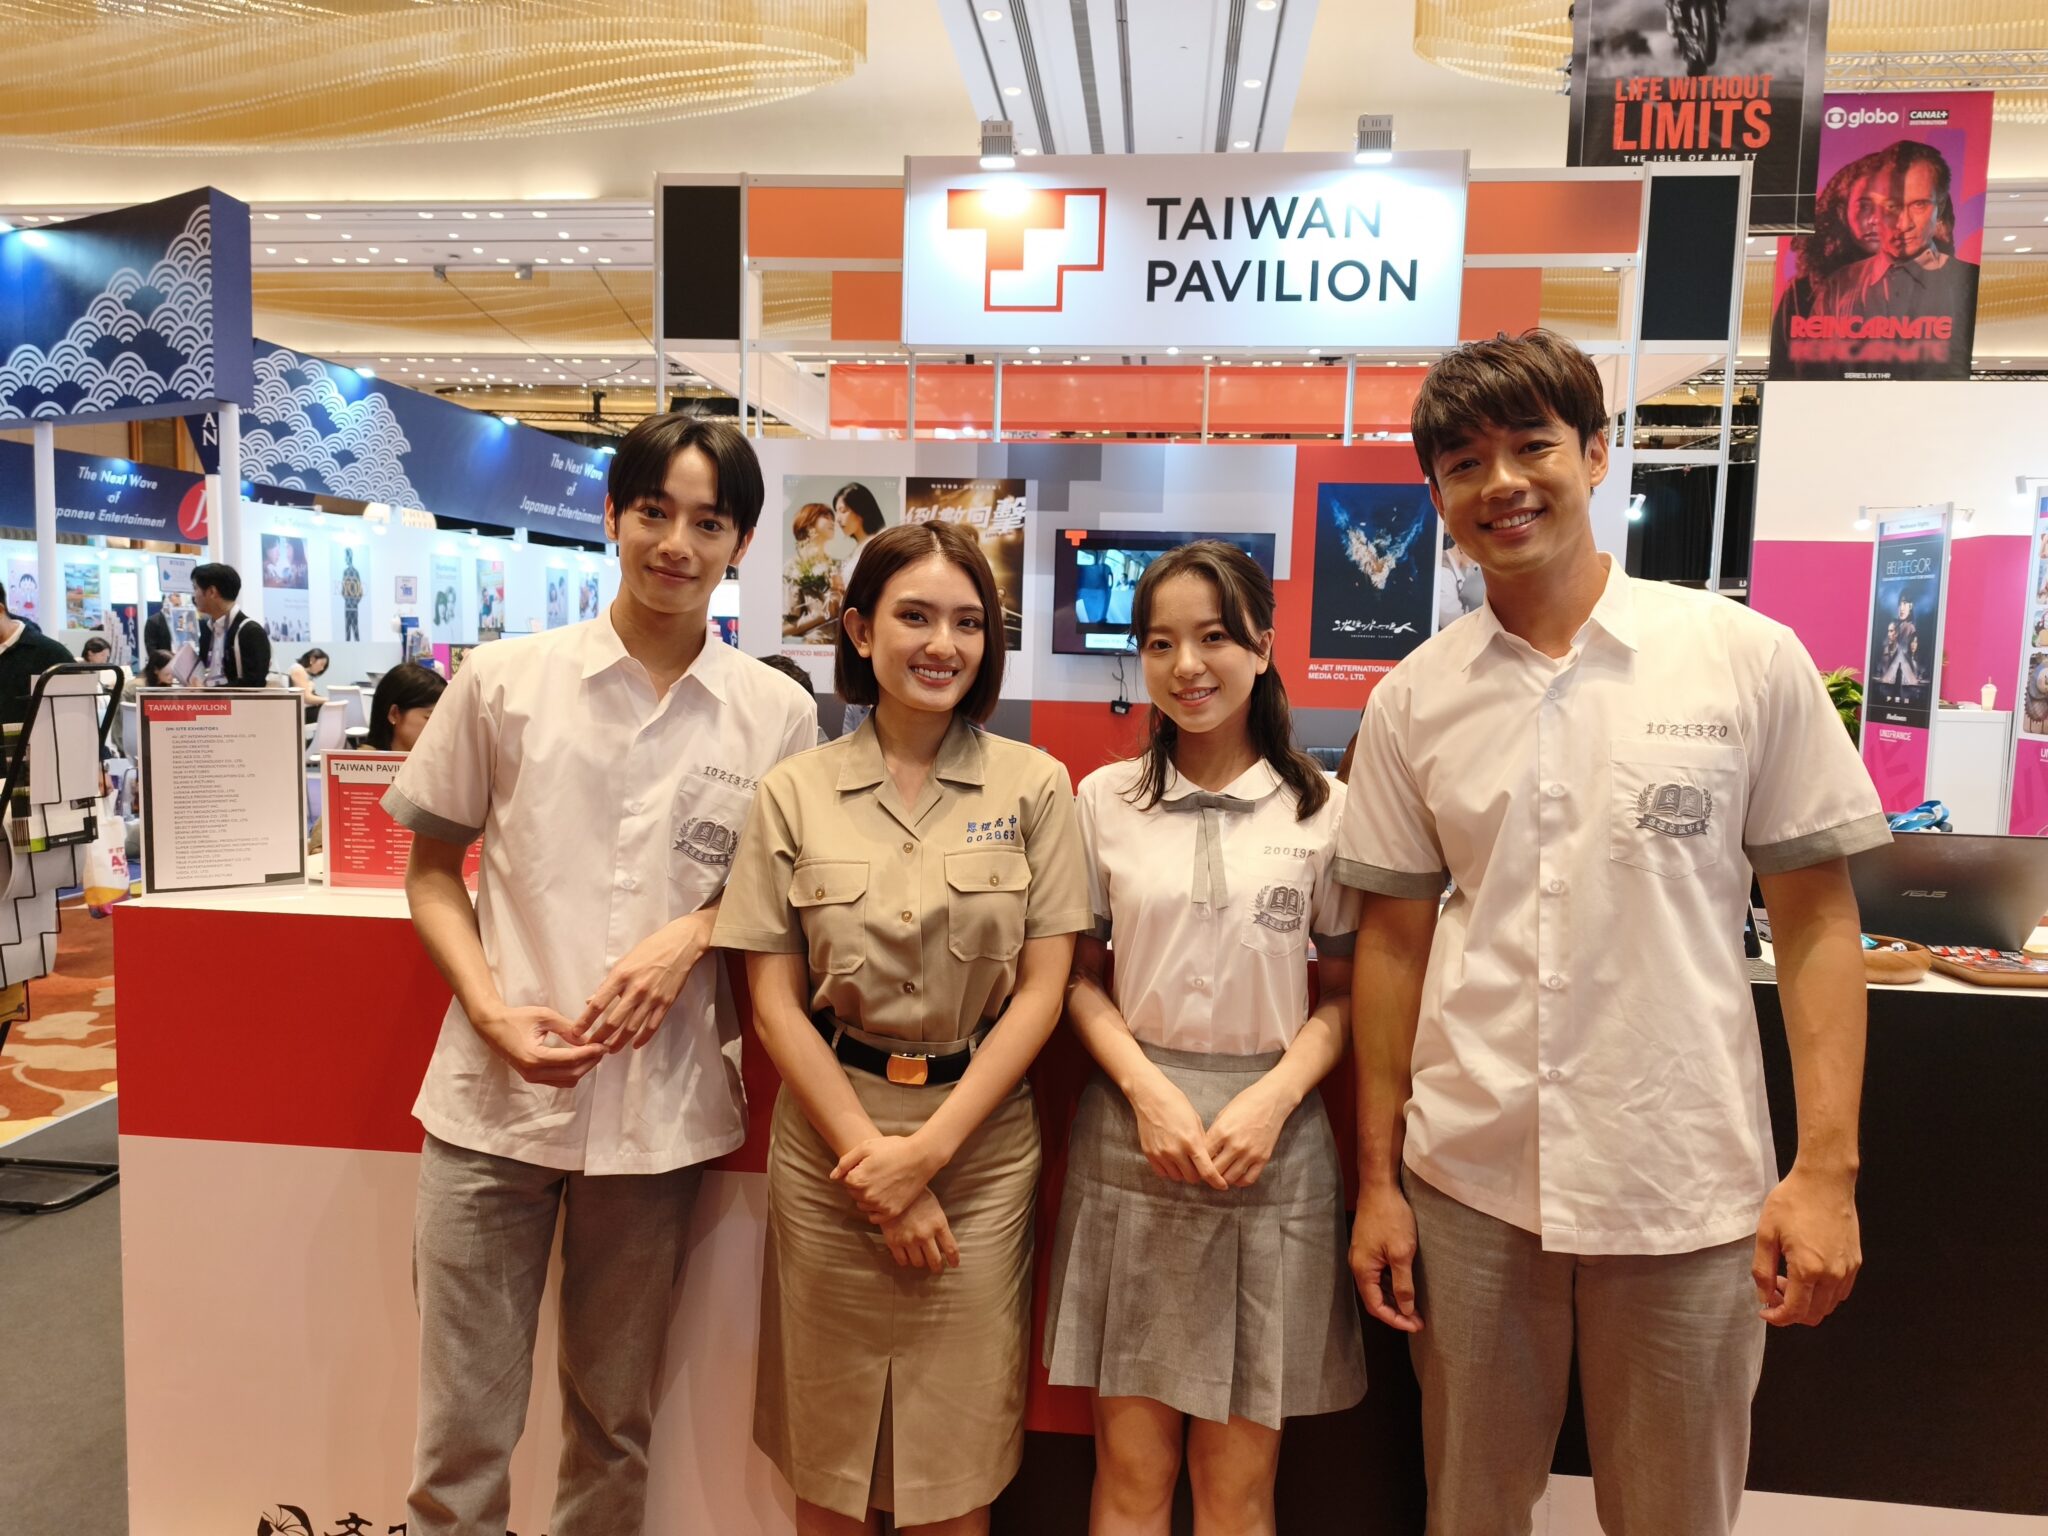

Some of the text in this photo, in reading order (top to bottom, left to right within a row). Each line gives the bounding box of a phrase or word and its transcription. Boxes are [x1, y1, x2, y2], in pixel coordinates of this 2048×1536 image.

[1615, 74, 1774, 101] LIFE WITHOUT
[1613, 100, 1772, 150] LIMITS
[1848, 108, 1899, 128] globo
[1146, 196, 1380, 240] TAIWAN
[1146, 259, 1418, 302] PAVILION
[1790, 315, 1952, 339] REINCARNATE
[551, 453, 604, 480] The Next Wave
[78, 466, 158, 490] The Next Wave
[566, 482, 578, 496] of
[107, 490, 122, 504] of
[98, 508, 166, 528] Entertainment
[520, 495, 602, 524] Japanese Entertainment
[1886, 558, 1931, 575] BELPHEGOR
[1646, 722, 1728, 738] 1021320
[334, 763, 373, 772] TAIWAN
[704, 766, 758, 791] 1021325
[967, 830, 1015, 843] 002863
[1901, 890, 1948, 898] ASUS
